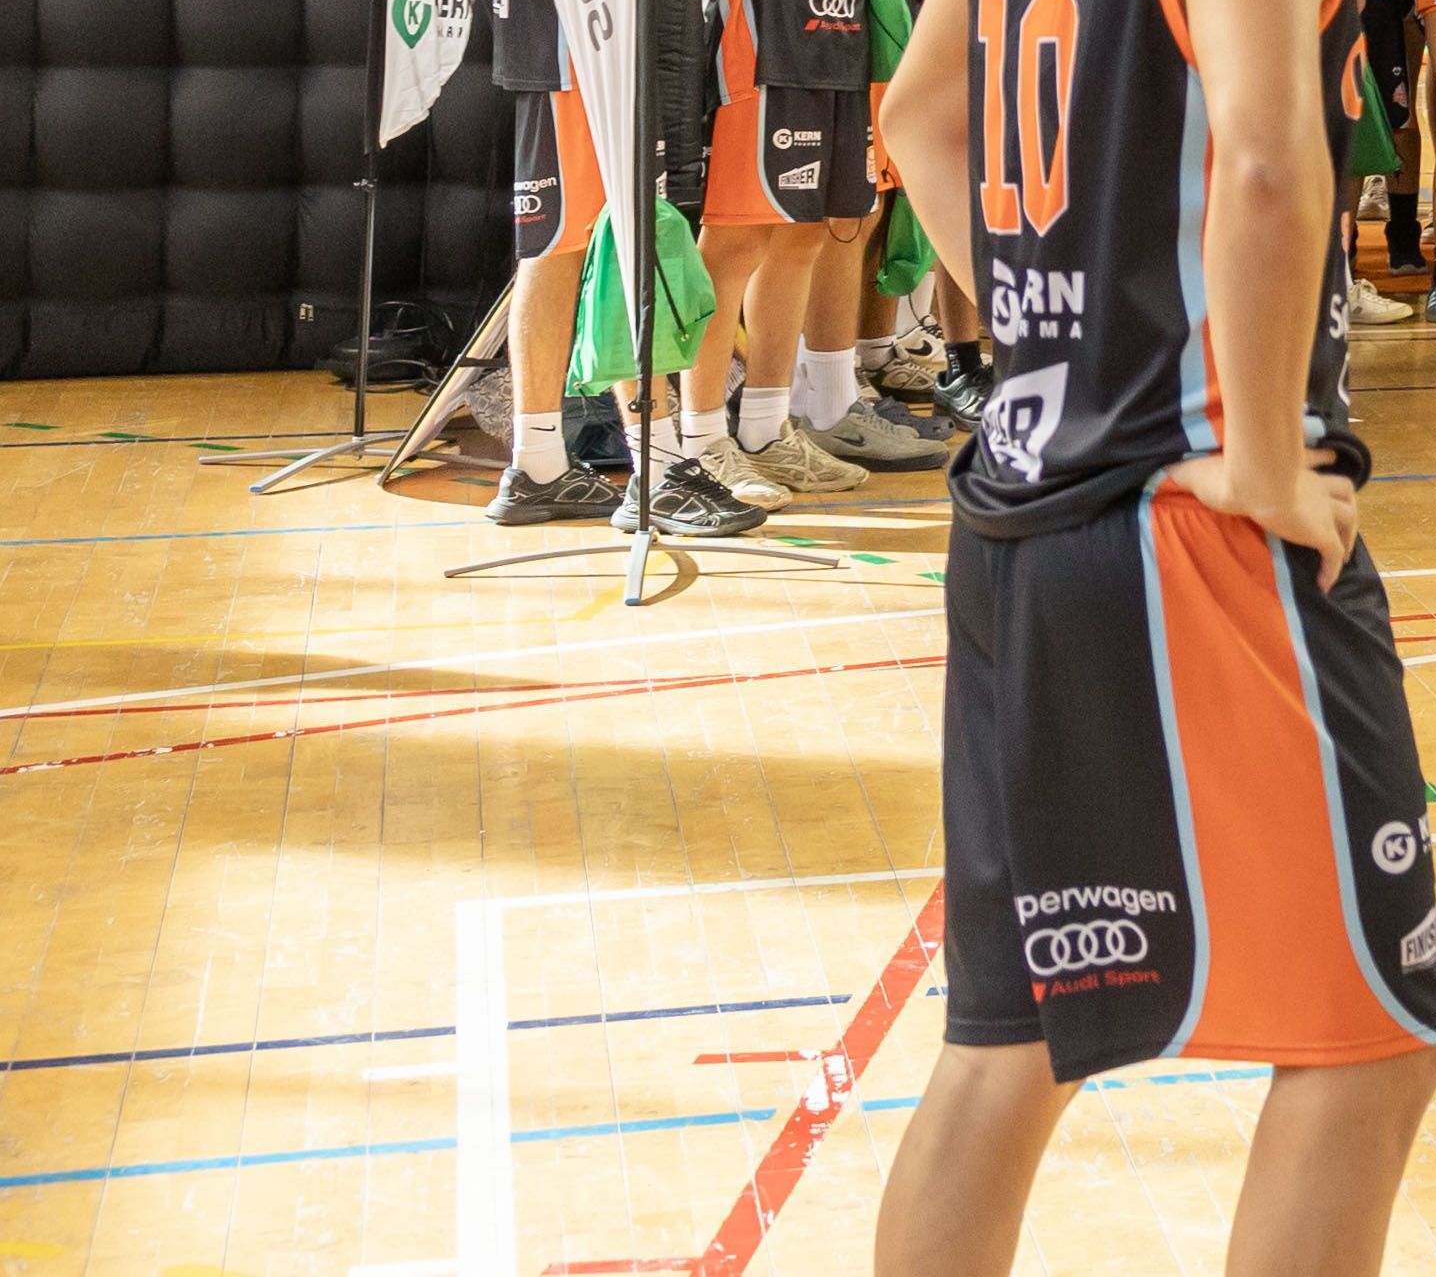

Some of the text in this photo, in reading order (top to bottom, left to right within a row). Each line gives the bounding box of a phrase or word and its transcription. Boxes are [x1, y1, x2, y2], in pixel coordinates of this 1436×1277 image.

[794, 130, 822, 141] KERN
[1049, 967, 1161, 997] Audi Sport
